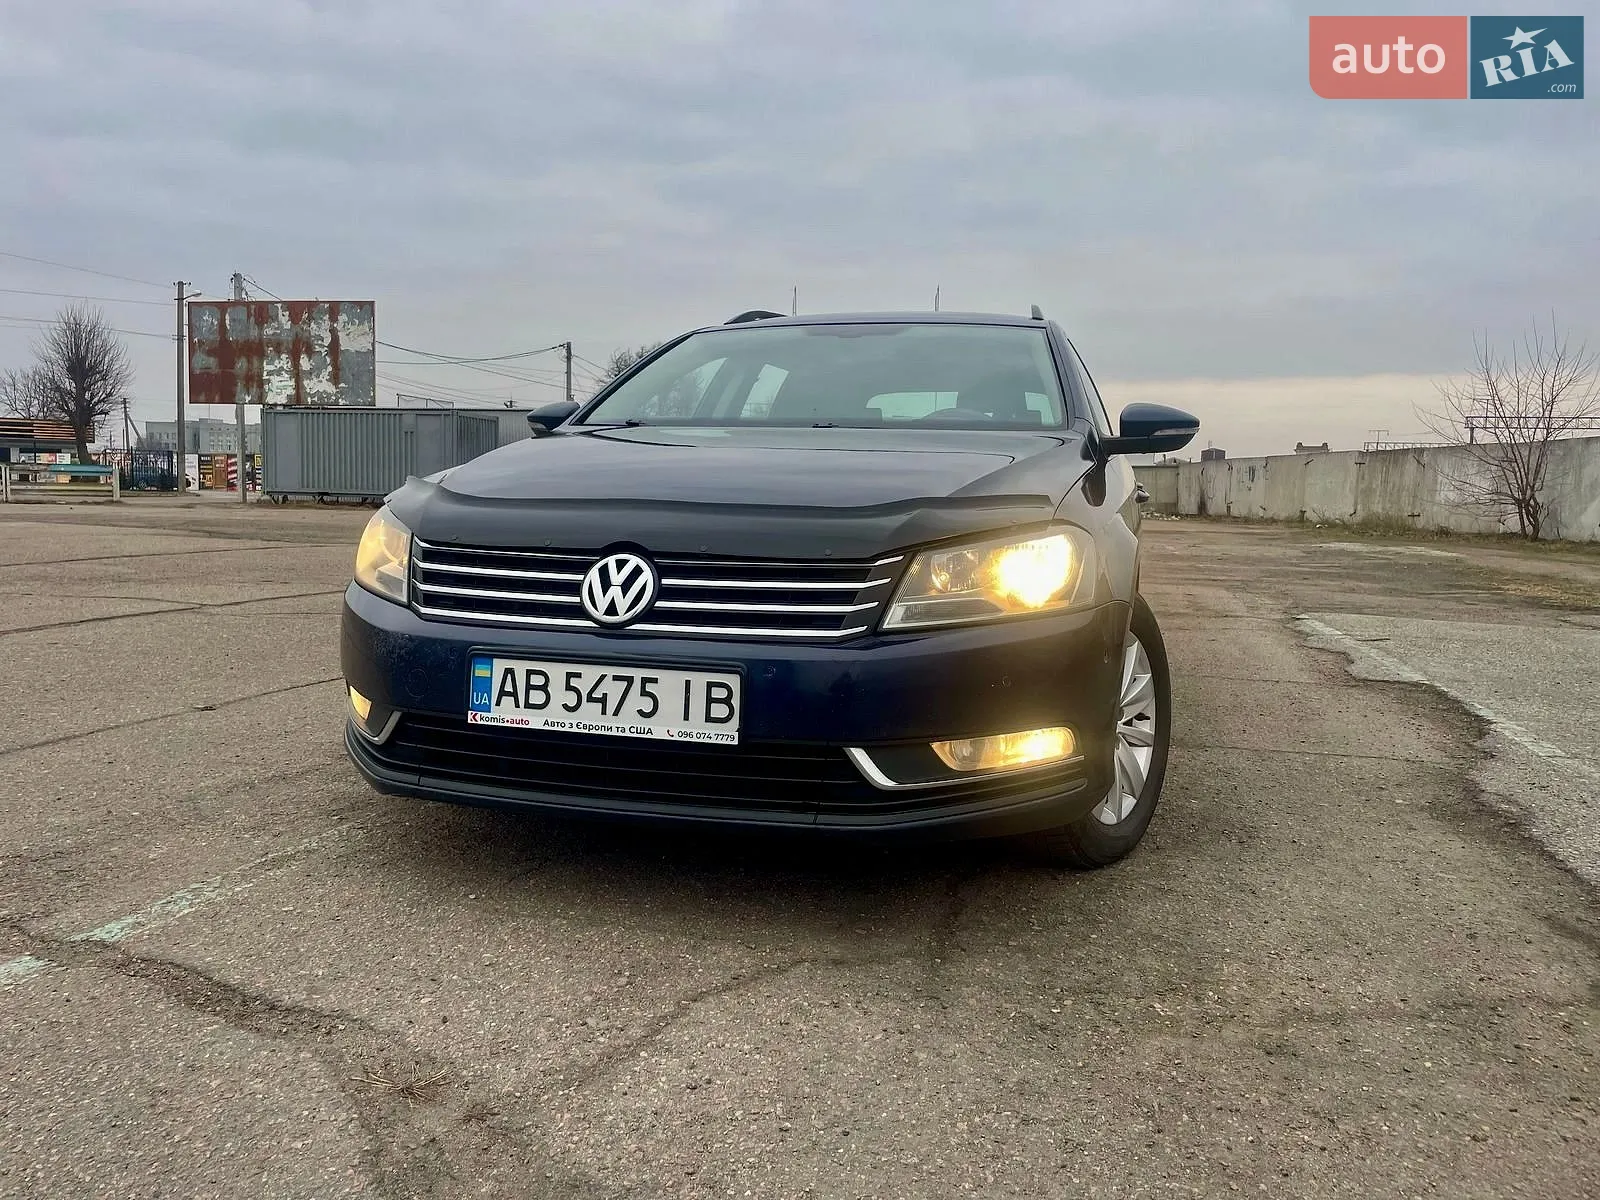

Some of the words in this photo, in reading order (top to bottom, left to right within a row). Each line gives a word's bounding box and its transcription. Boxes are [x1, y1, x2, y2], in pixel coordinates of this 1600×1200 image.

[473, 692, 490, 706] UA
[495, 667, 552, 710] AB
[561, 671, 659, 719] 5475
[682, 679, 736, 725] IB
[543, 718, 567, 729] Авто
[575, 721, 613, 733] Європи
[615, 726, 626, 734] та
[628, 725, 654, 736] США
[677, 730, 694, 740] 096
[695, 731, 713, 741] 074
[714, 733, 736, 742] 7779
